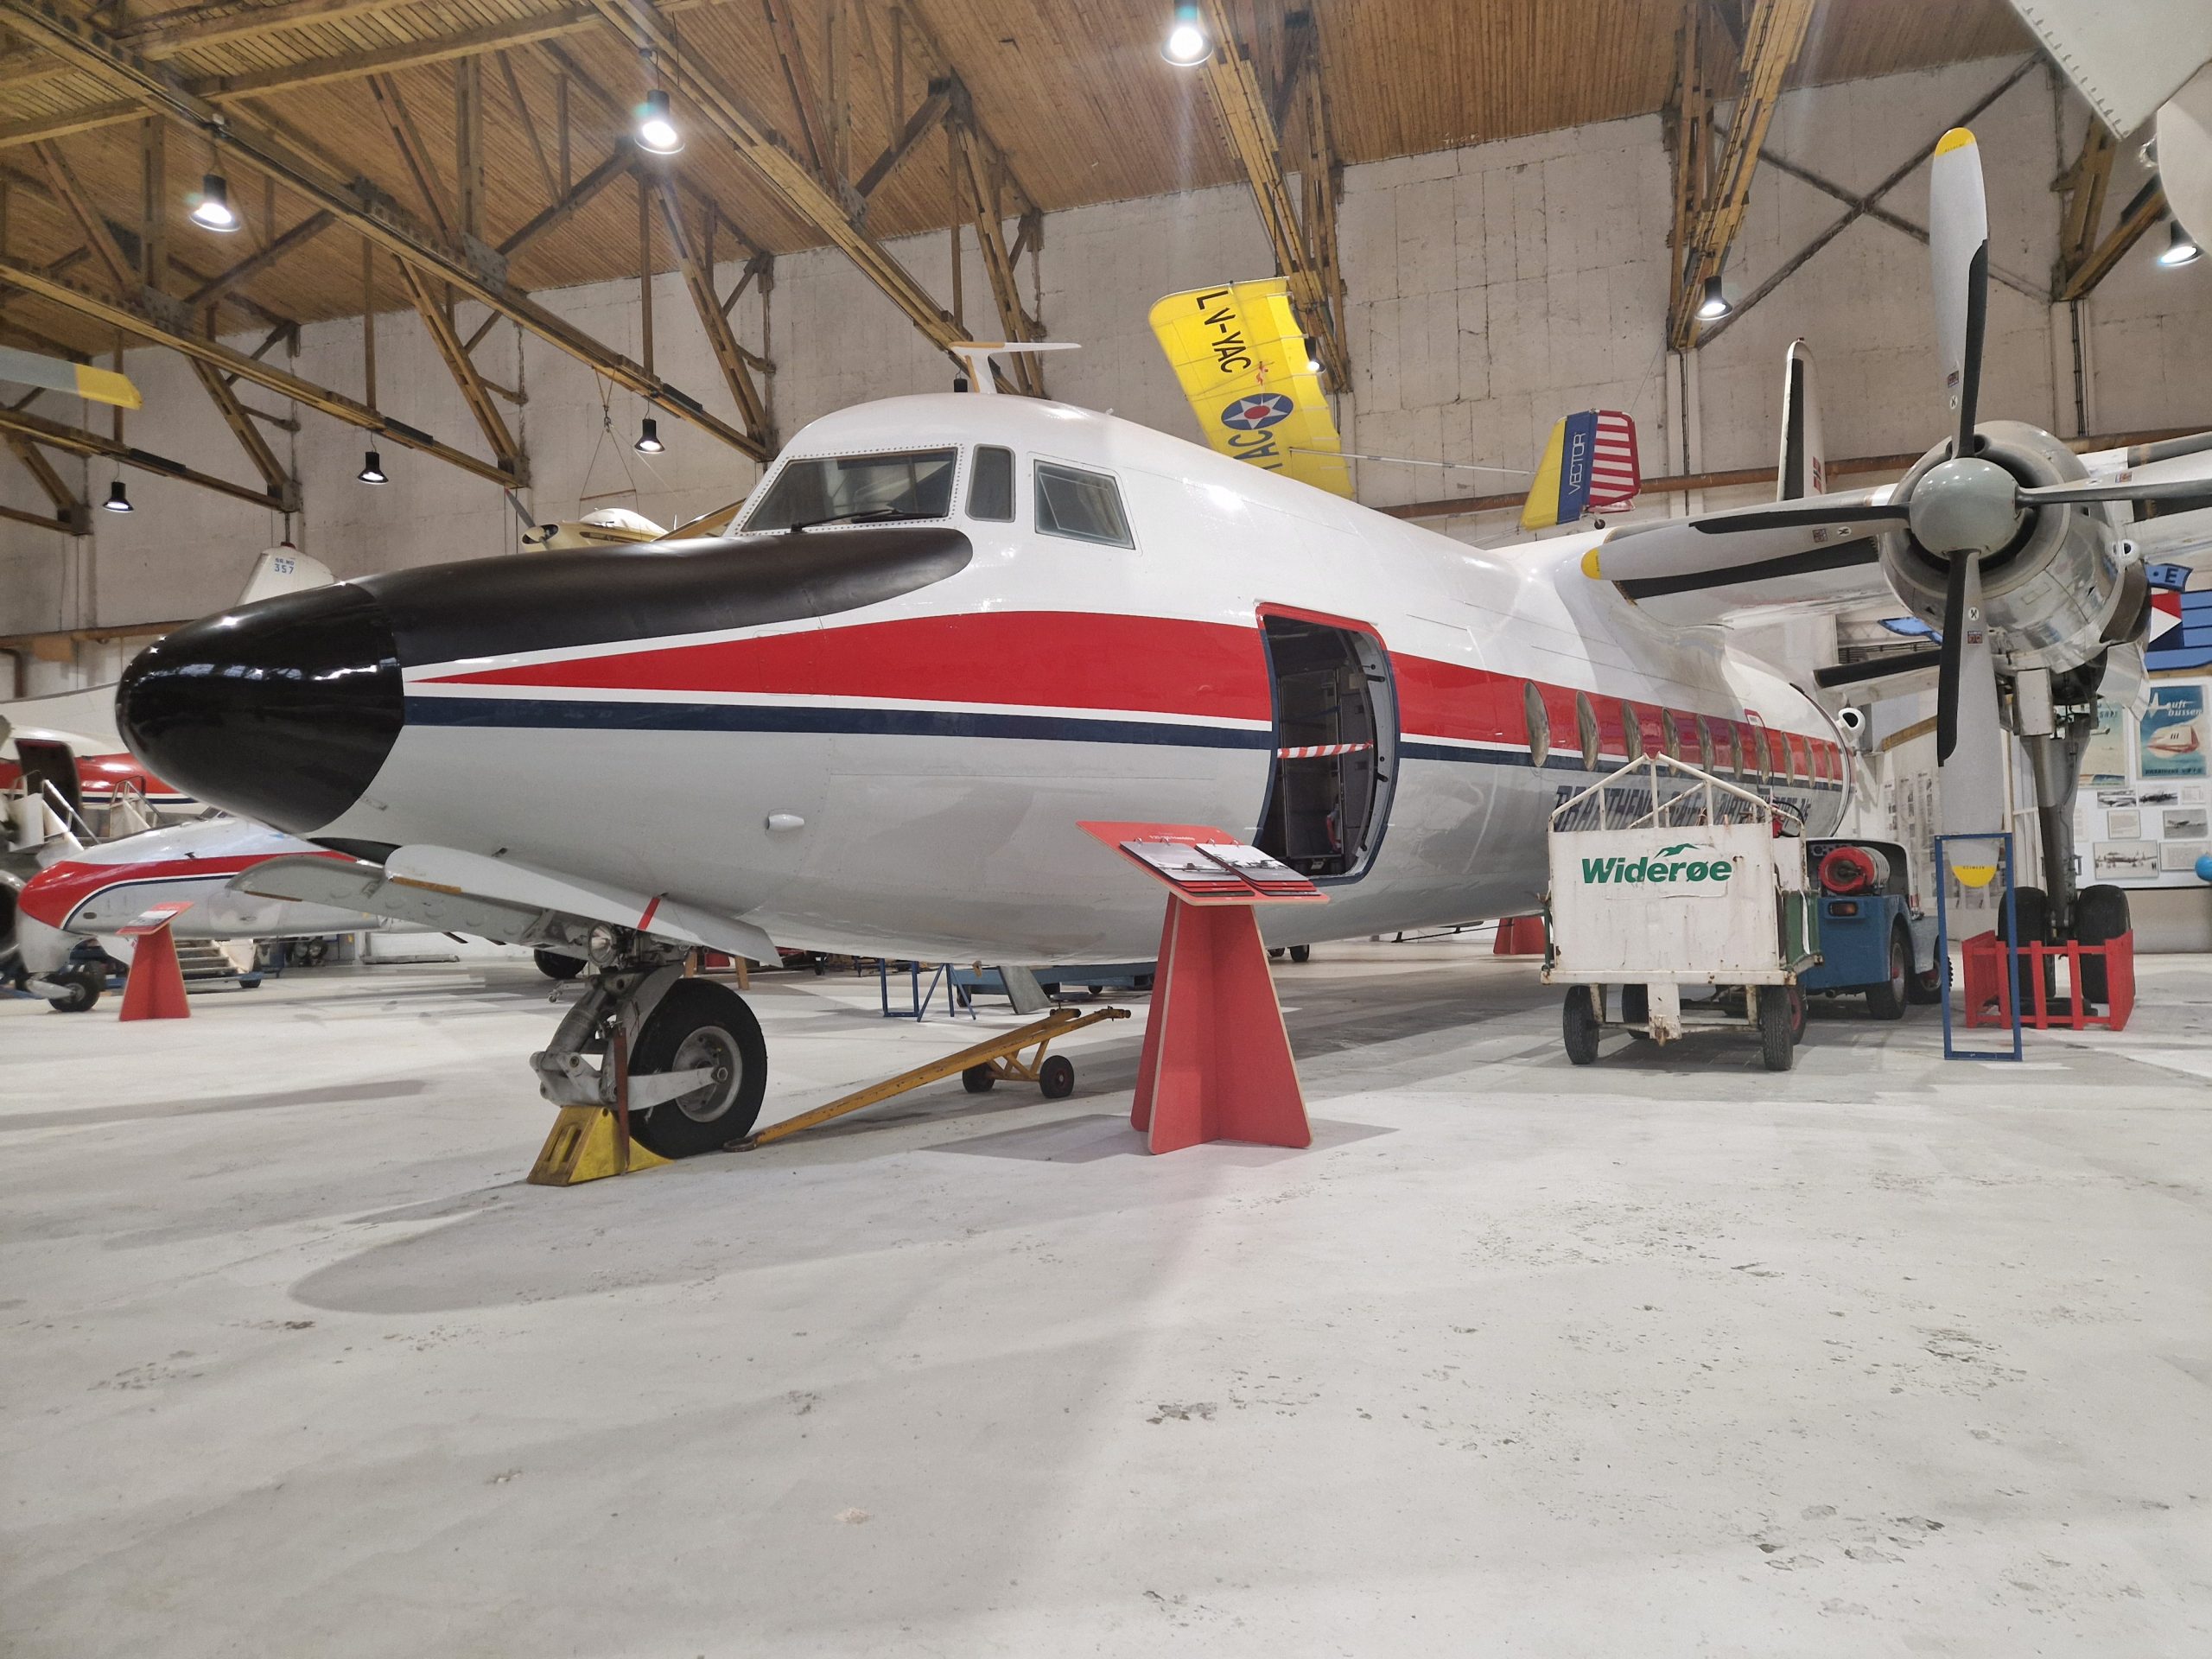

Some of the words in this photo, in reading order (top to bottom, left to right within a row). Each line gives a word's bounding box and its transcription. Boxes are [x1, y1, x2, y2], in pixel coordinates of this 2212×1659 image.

[1568, 432, 1586, 495] VECTOR
[274, 563, 295, 575] 357
[1581, 856, 1732, 884] Widerøe
